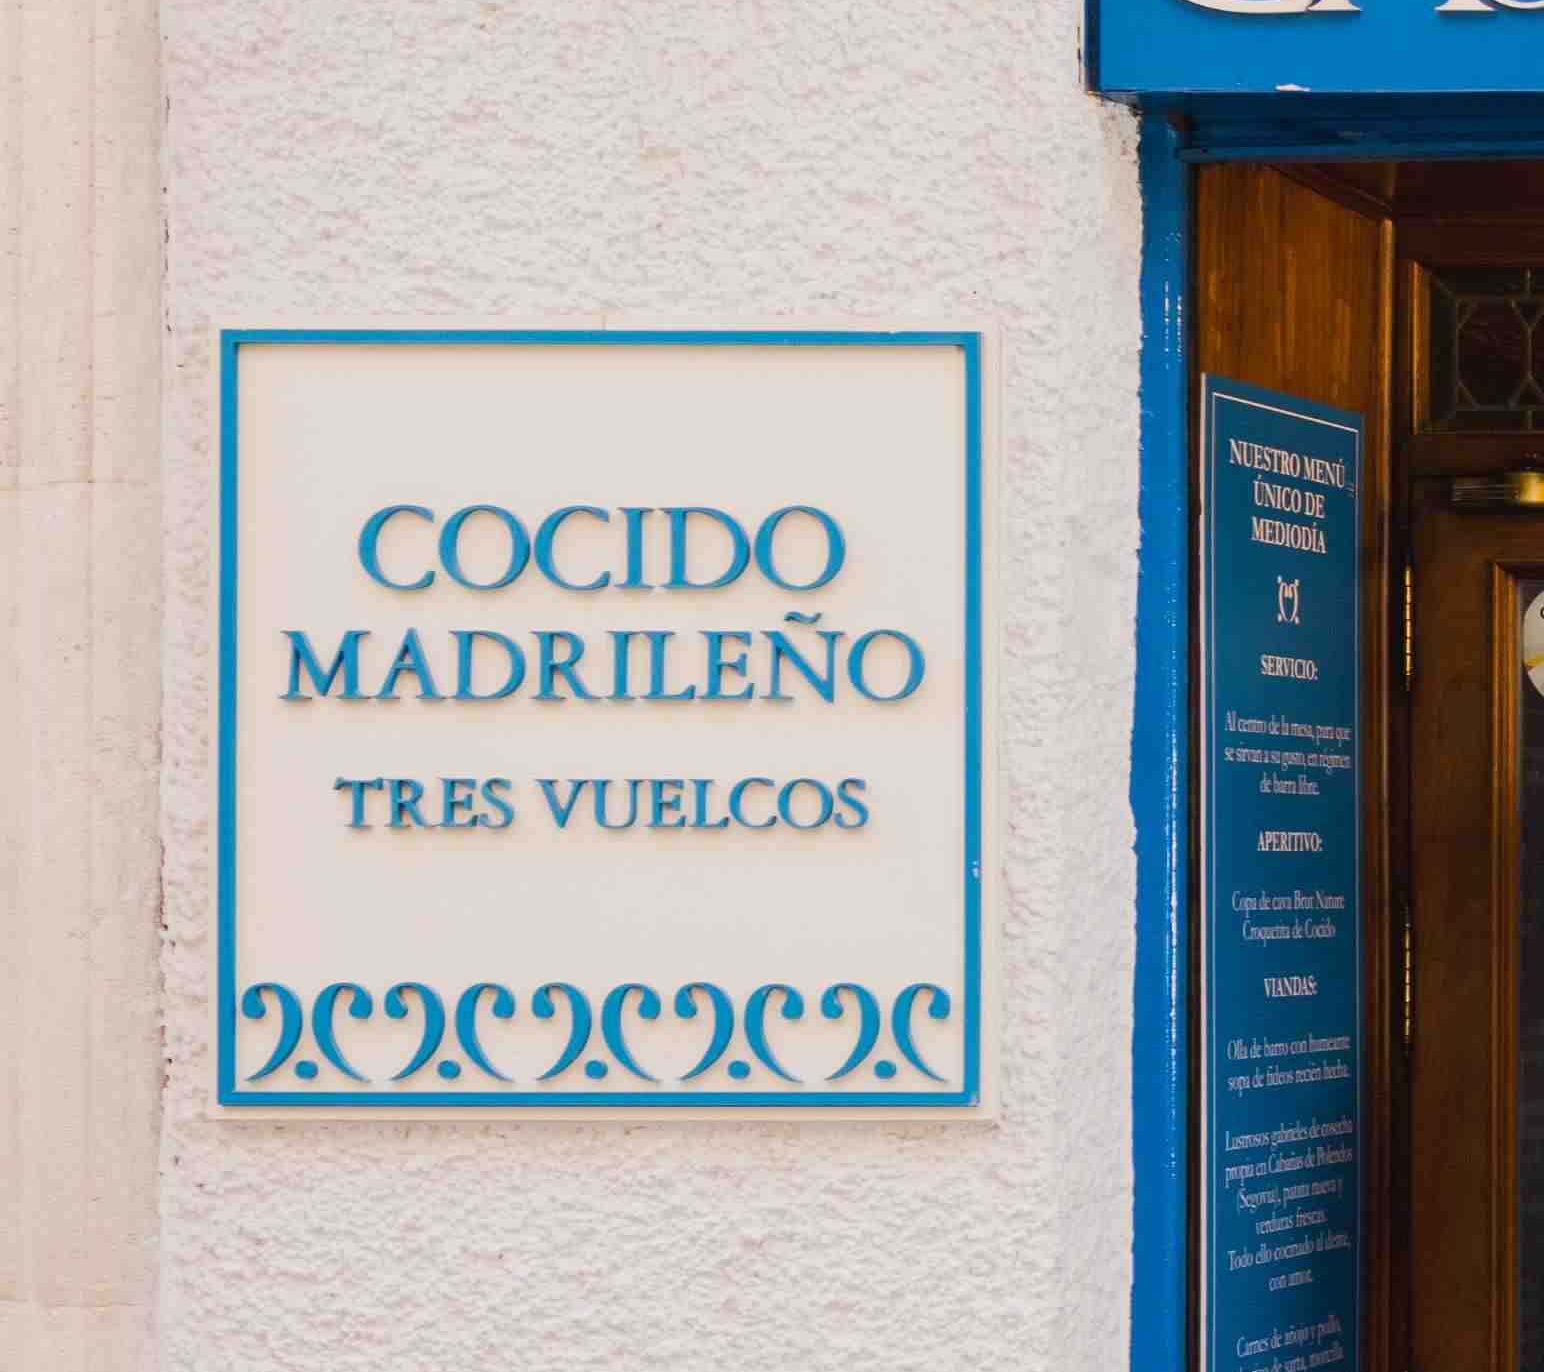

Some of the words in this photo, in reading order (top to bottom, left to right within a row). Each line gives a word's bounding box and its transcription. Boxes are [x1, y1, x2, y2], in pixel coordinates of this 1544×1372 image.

[1229, 438, 1300, 479] NUESTRO
[1303, 456, 1345, 488] MENÚ
[1253, 475, 1301, 513] ÚNICO
[1304, 491, 1326, 518] DE
[358, 504, 847, 596] COCIDO
[1251, 515, 1328, 554] MEDIODÍA
[279, 611, 927, 705] MADRILEÑO
[1261, 654, 1319, 680] SERVICIO:
[333, 777, 516, 831] TRES
[535, 777, 870, 831] VUELCOS
[1257, 830, 1323, 851] APERITIVO:
[1232, 890, 1257, 918] Copa
[1264, 975, 1319, 997] VIANDAS:
